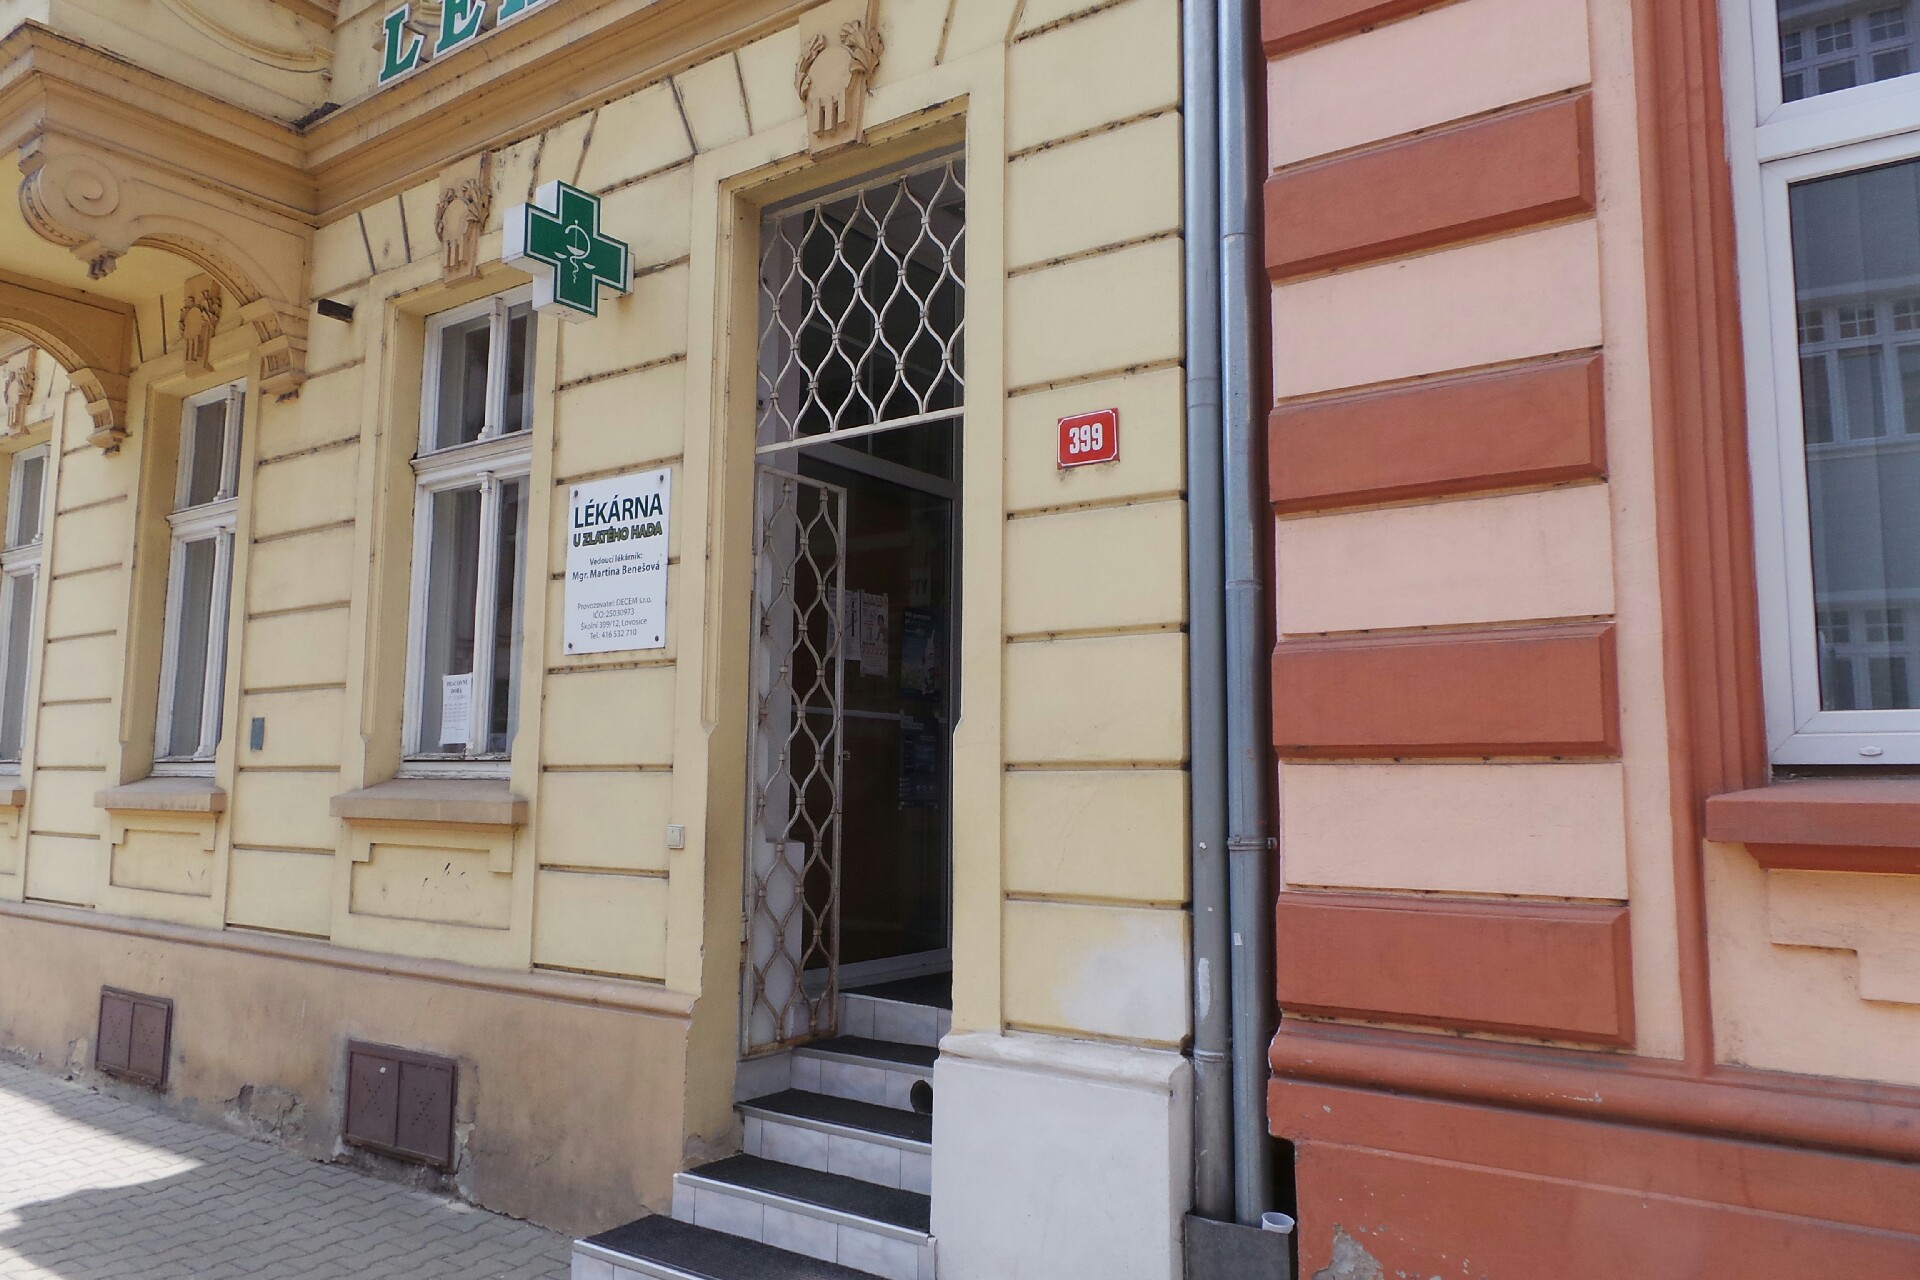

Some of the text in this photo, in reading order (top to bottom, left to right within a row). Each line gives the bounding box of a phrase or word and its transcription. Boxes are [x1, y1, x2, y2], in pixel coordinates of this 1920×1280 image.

[1069, 422, 1103, 454] 399
[574, 493, 663, 528] LÉKÁRNA
[573, 521, 663, 547] U ZLATÉHO HADA
[589, 555, 614, 565] Vedoucí
[572, 560, 660, 582] Mgr. Martina Benešová
[578, 601, 615, 610] Provozovatel:
[616, 598, 638, 606] DECEM
[580, 618, 648, 630] Školní 399/12, Lovosice
[626, 628, 637, 636] 710
